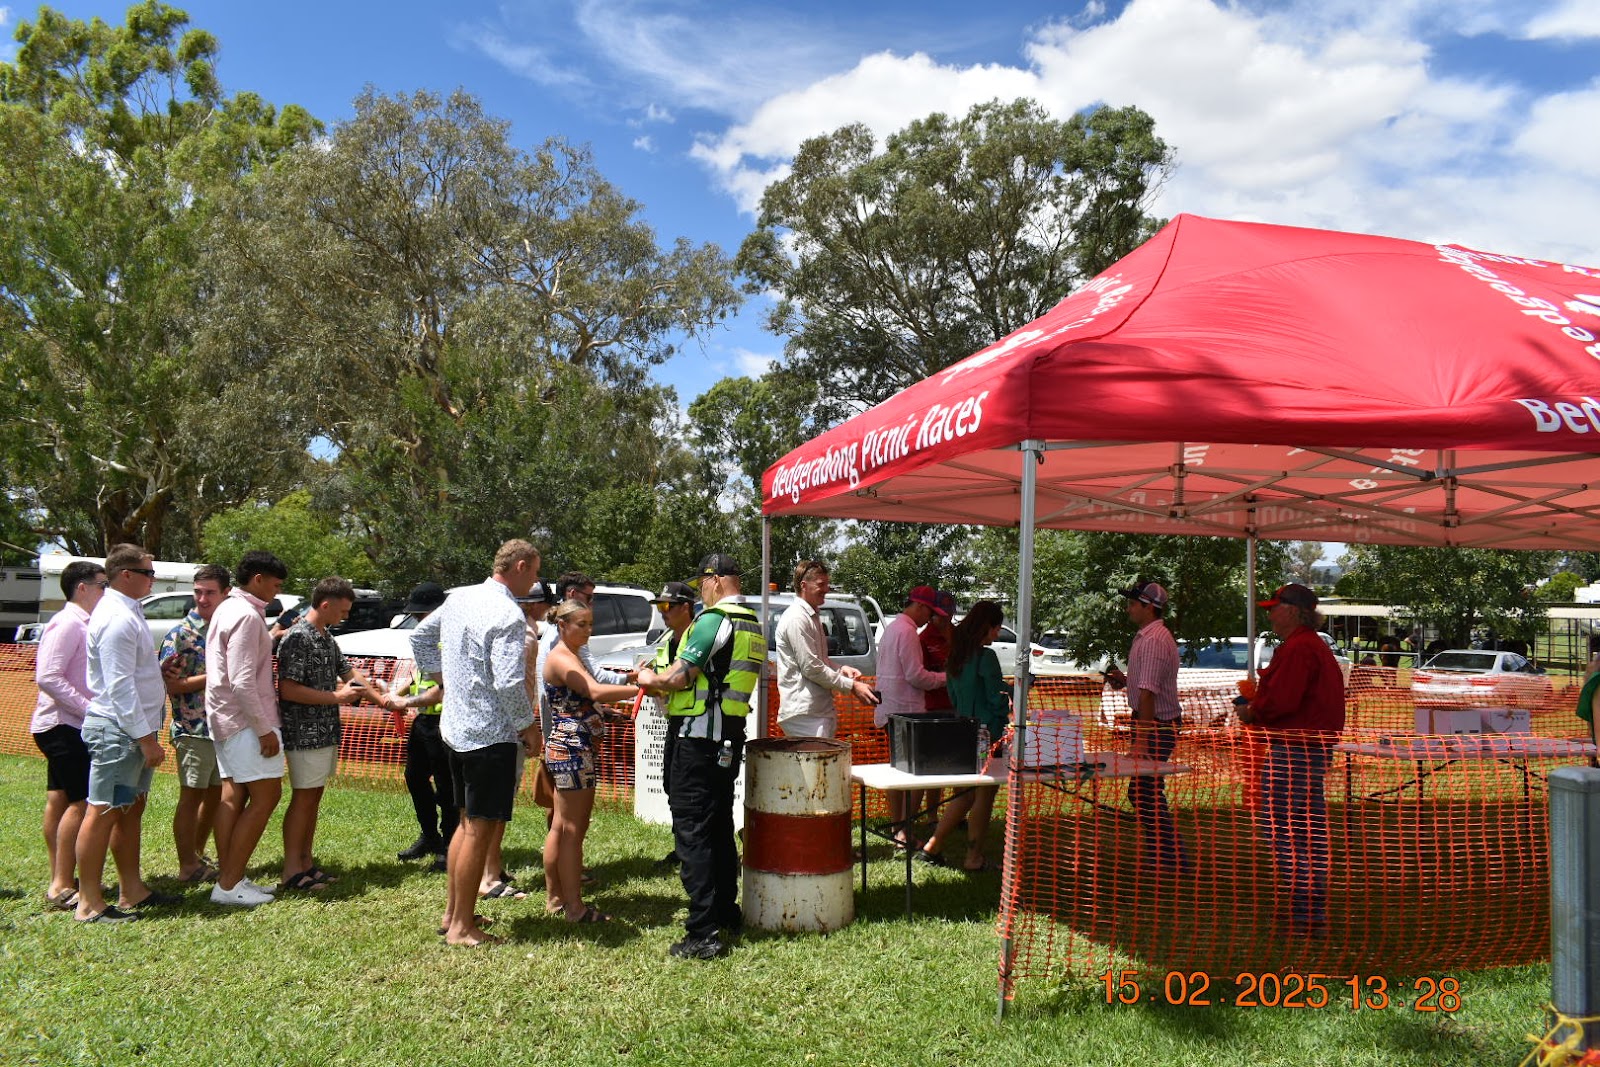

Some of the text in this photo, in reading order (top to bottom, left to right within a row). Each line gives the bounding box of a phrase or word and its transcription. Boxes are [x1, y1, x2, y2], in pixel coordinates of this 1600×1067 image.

[771, 390, 990, 504] Bedgerabong Picnic Races
